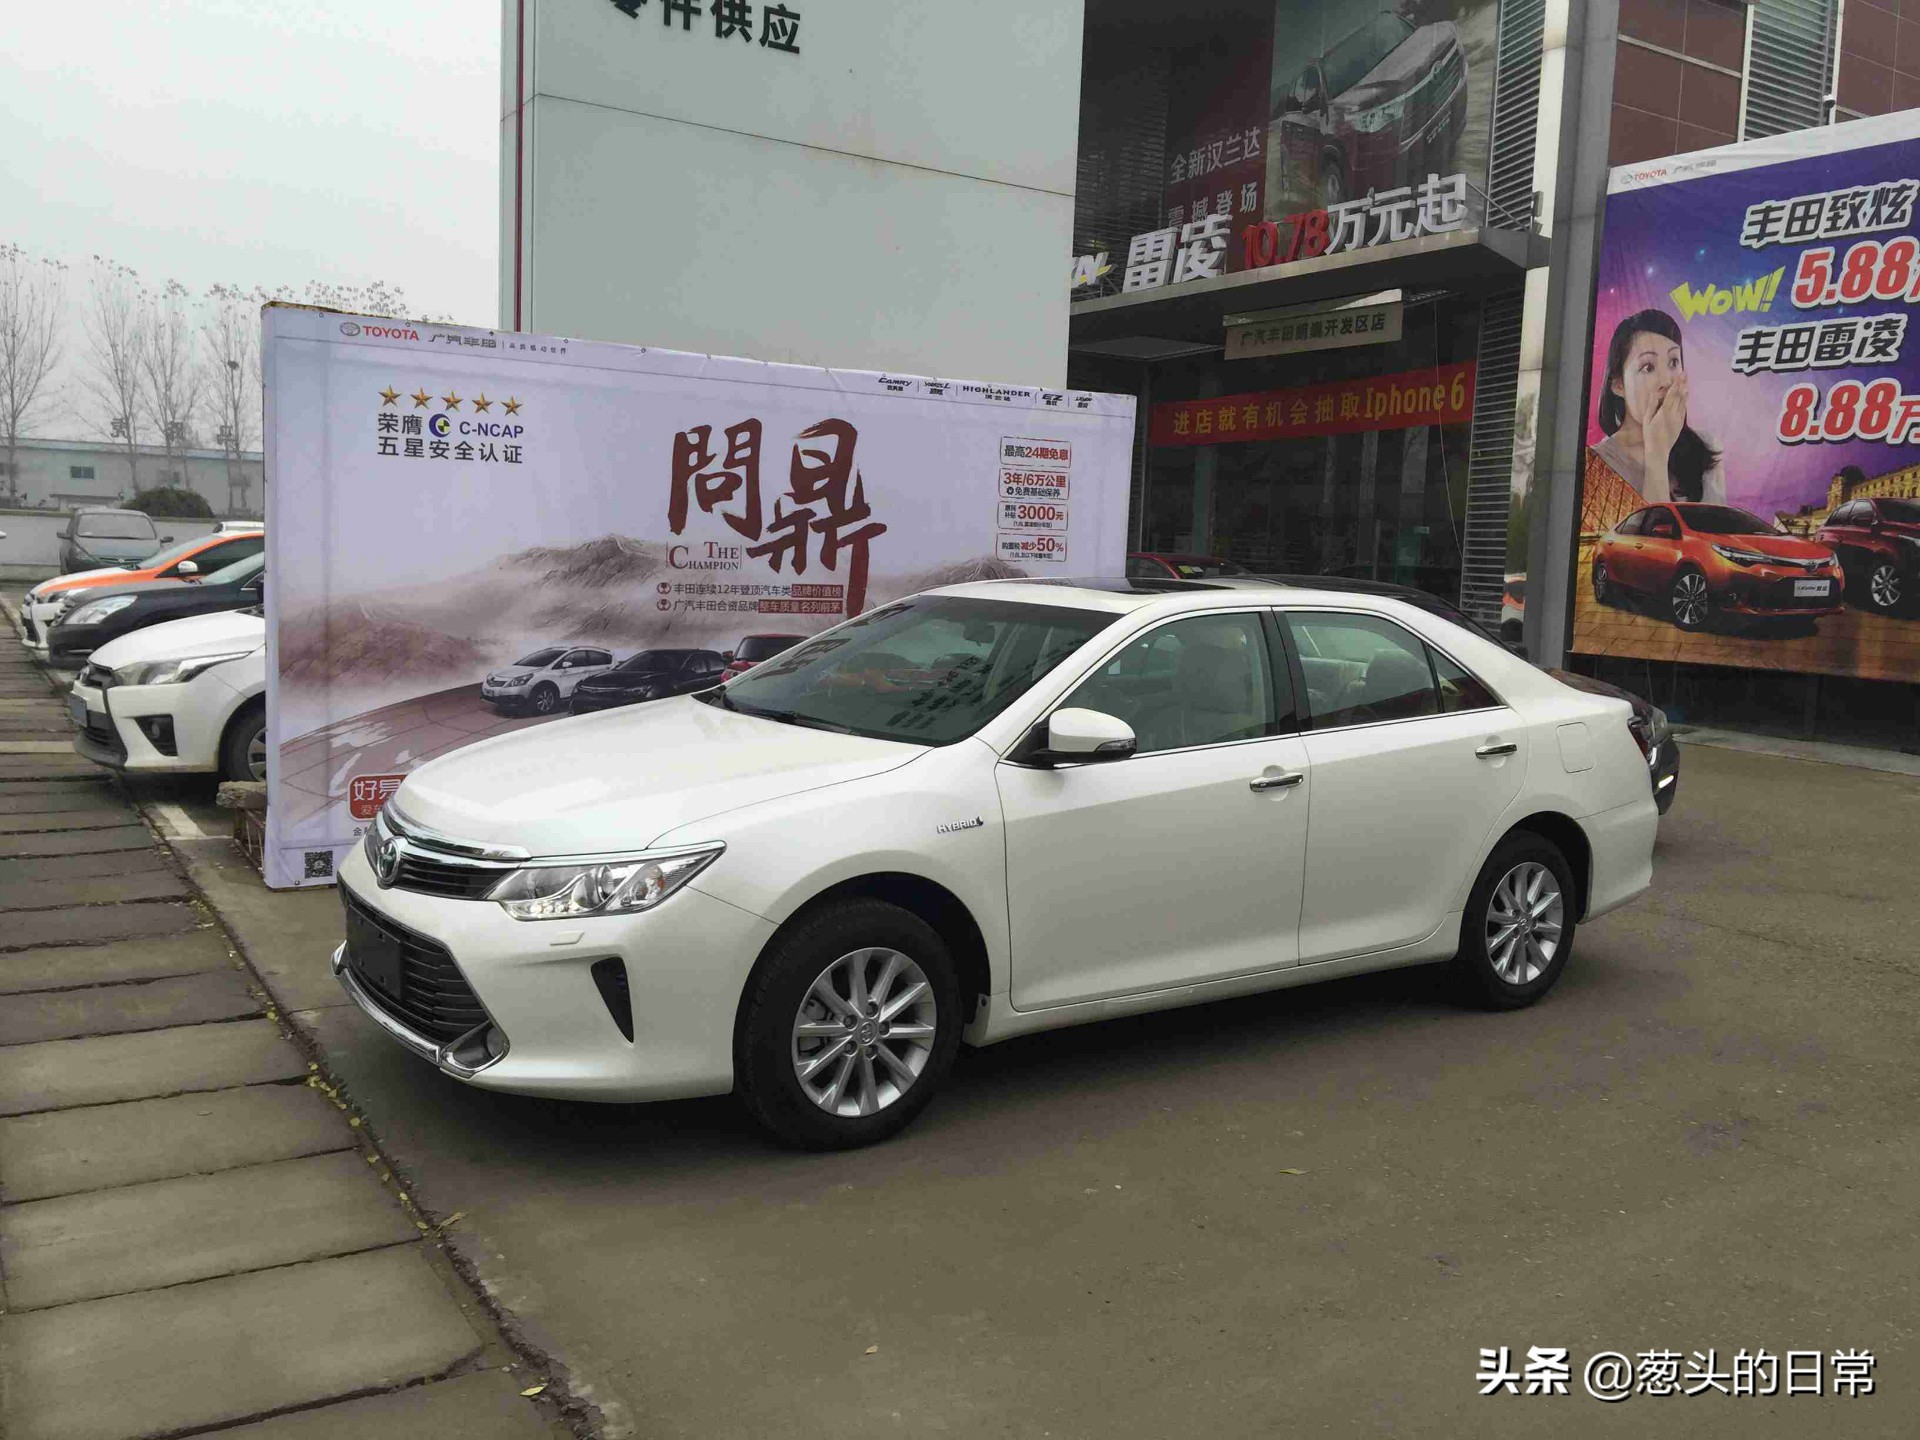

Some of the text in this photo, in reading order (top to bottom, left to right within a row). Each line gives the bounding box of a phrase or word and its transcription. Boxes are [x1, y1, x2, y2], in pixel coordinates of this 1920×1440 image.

[1170, 126, 1260, 184] 全新汉兰达
[1634, 169, 1667, 181] TOYOTA
[1744, 184, 1915, 243] 丰田致炫
[363, 326, 419, 341] TOYOTA
[1735, 318, 1902, 367] 丰田雷凌
[963, 386, 1030, 397] HIGHLANDER
[378, 413, 524, 438] 荣膺 C-NCAP
[377, 436, 523, 464] 五星安全认证
[1004, 445, 1068, 460] 最高24期免息
[1004, 472, 1066, 487] 3年/6万公里
[1018, 505, 1064, 520] 3000元
[669, 545, 739, 570] CHAMPION
[704, 541, 739, 559] THE
[936, 818, 977, 834] HYBRID
